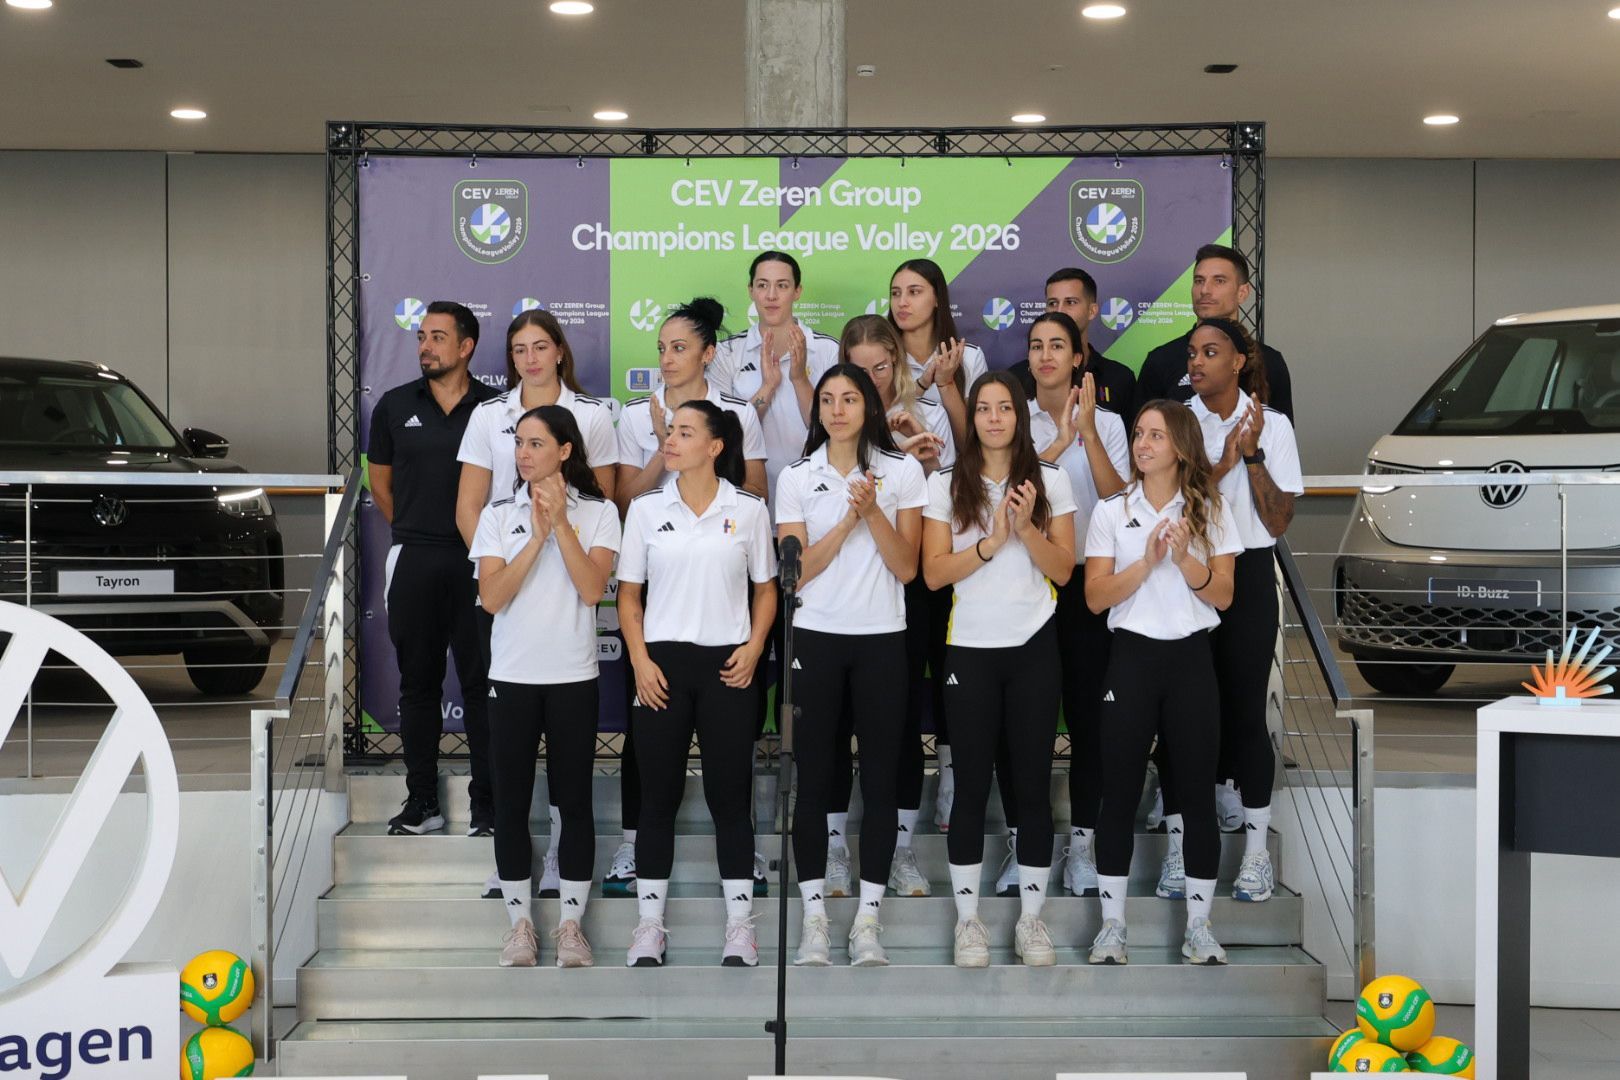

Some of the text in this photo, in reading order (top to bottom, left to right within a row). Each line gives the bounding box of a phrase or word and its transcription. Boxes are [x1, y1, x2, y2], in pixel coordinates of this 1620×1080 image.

[461, 187, 492, 200] CEV
[671, 179, 921, 214] CEV Zeren Group
[1078, 187, 1108, 200] CEV
[571, 222, 1020, 258] Champions League Volley 2026
[585, 302, 606, 310] Group
[586, 310, 610, 318] League
[95, 575, 140, 590] Tayron
[1457, 585, 1510, 600] ID. Buzz
